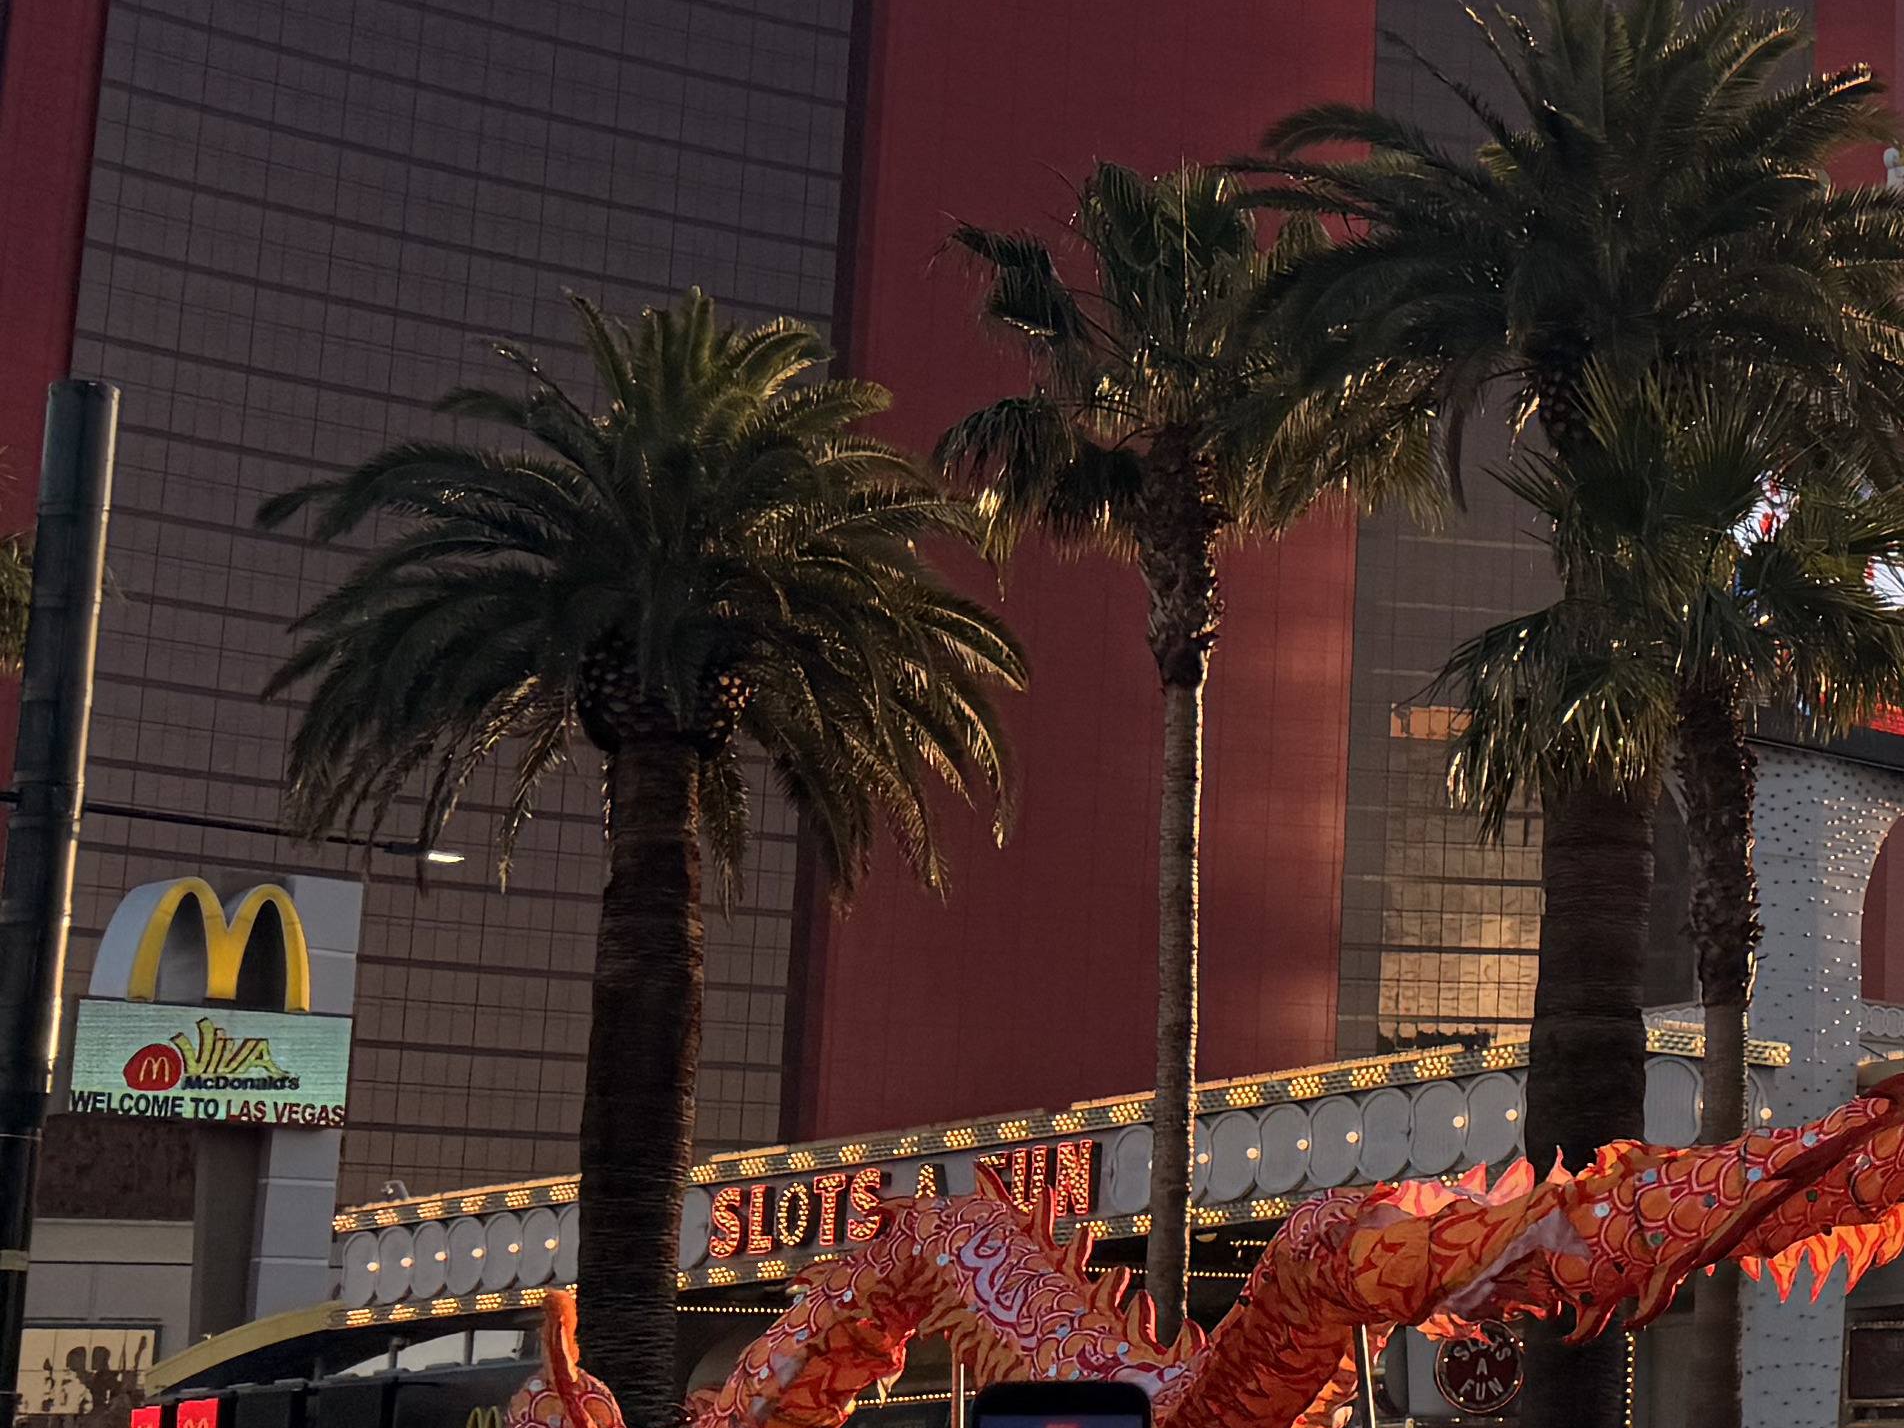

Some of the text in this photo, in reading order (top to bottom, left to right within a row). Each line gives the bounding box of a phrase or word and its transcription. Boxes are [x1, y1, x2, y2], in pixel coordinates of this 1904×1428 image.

[170, 1017, 290, 1075] VIVA
[182, 1075, 300, 1091] McDonald's
[69, 1089, 346, 1126] WELCOME TO LAS VEGAS
[710, 1167, 882, 1258] SLOTS
[914, 1162, 938, 1200] A
[1476, 1357, 1488, 1375] A
[1460, 1377, 1504, 1401] FUN
